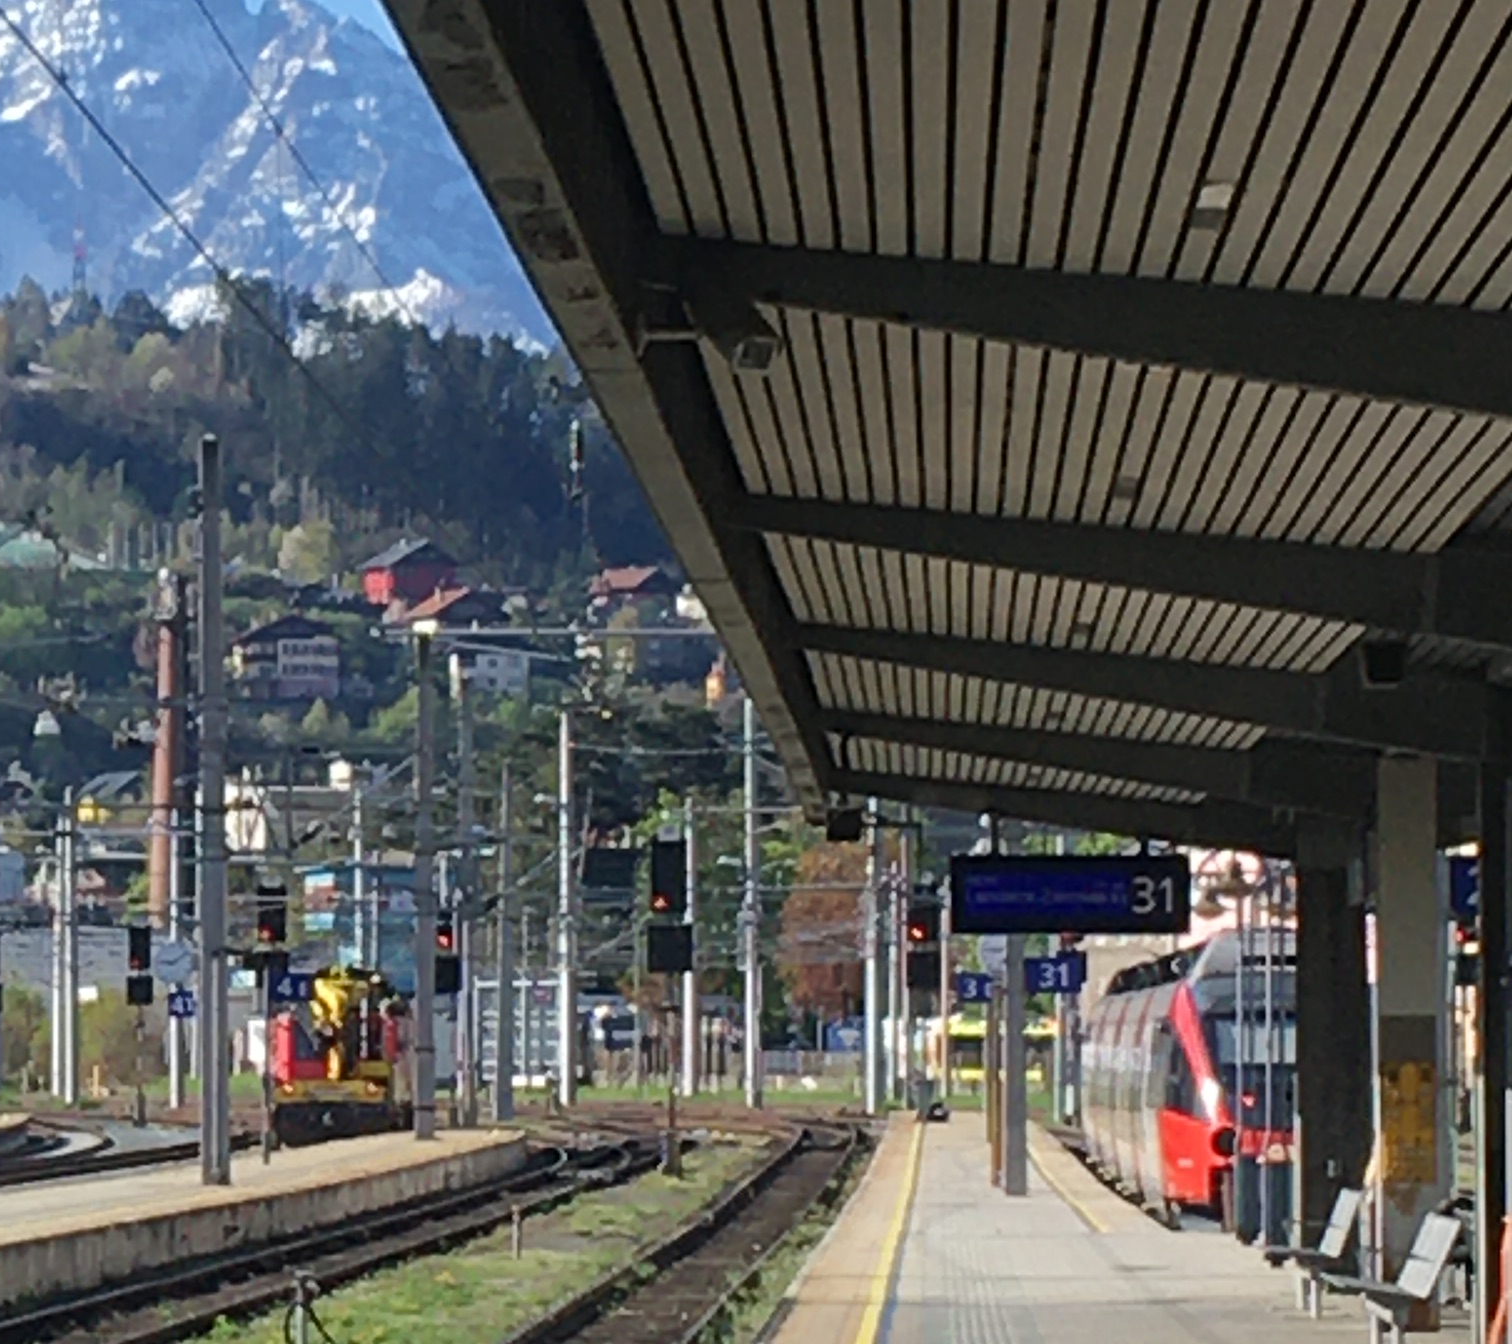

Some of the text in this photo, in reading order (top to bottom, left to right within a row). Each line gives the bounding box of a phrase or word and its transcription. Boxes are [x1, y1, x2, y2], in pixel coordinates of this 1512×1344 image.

[1132, 875, 1175, 915] 31
[276, 976, 293, 997] 4
[1040, 962, 1070, 989] 31
[962, 977, 978, 999] 3
